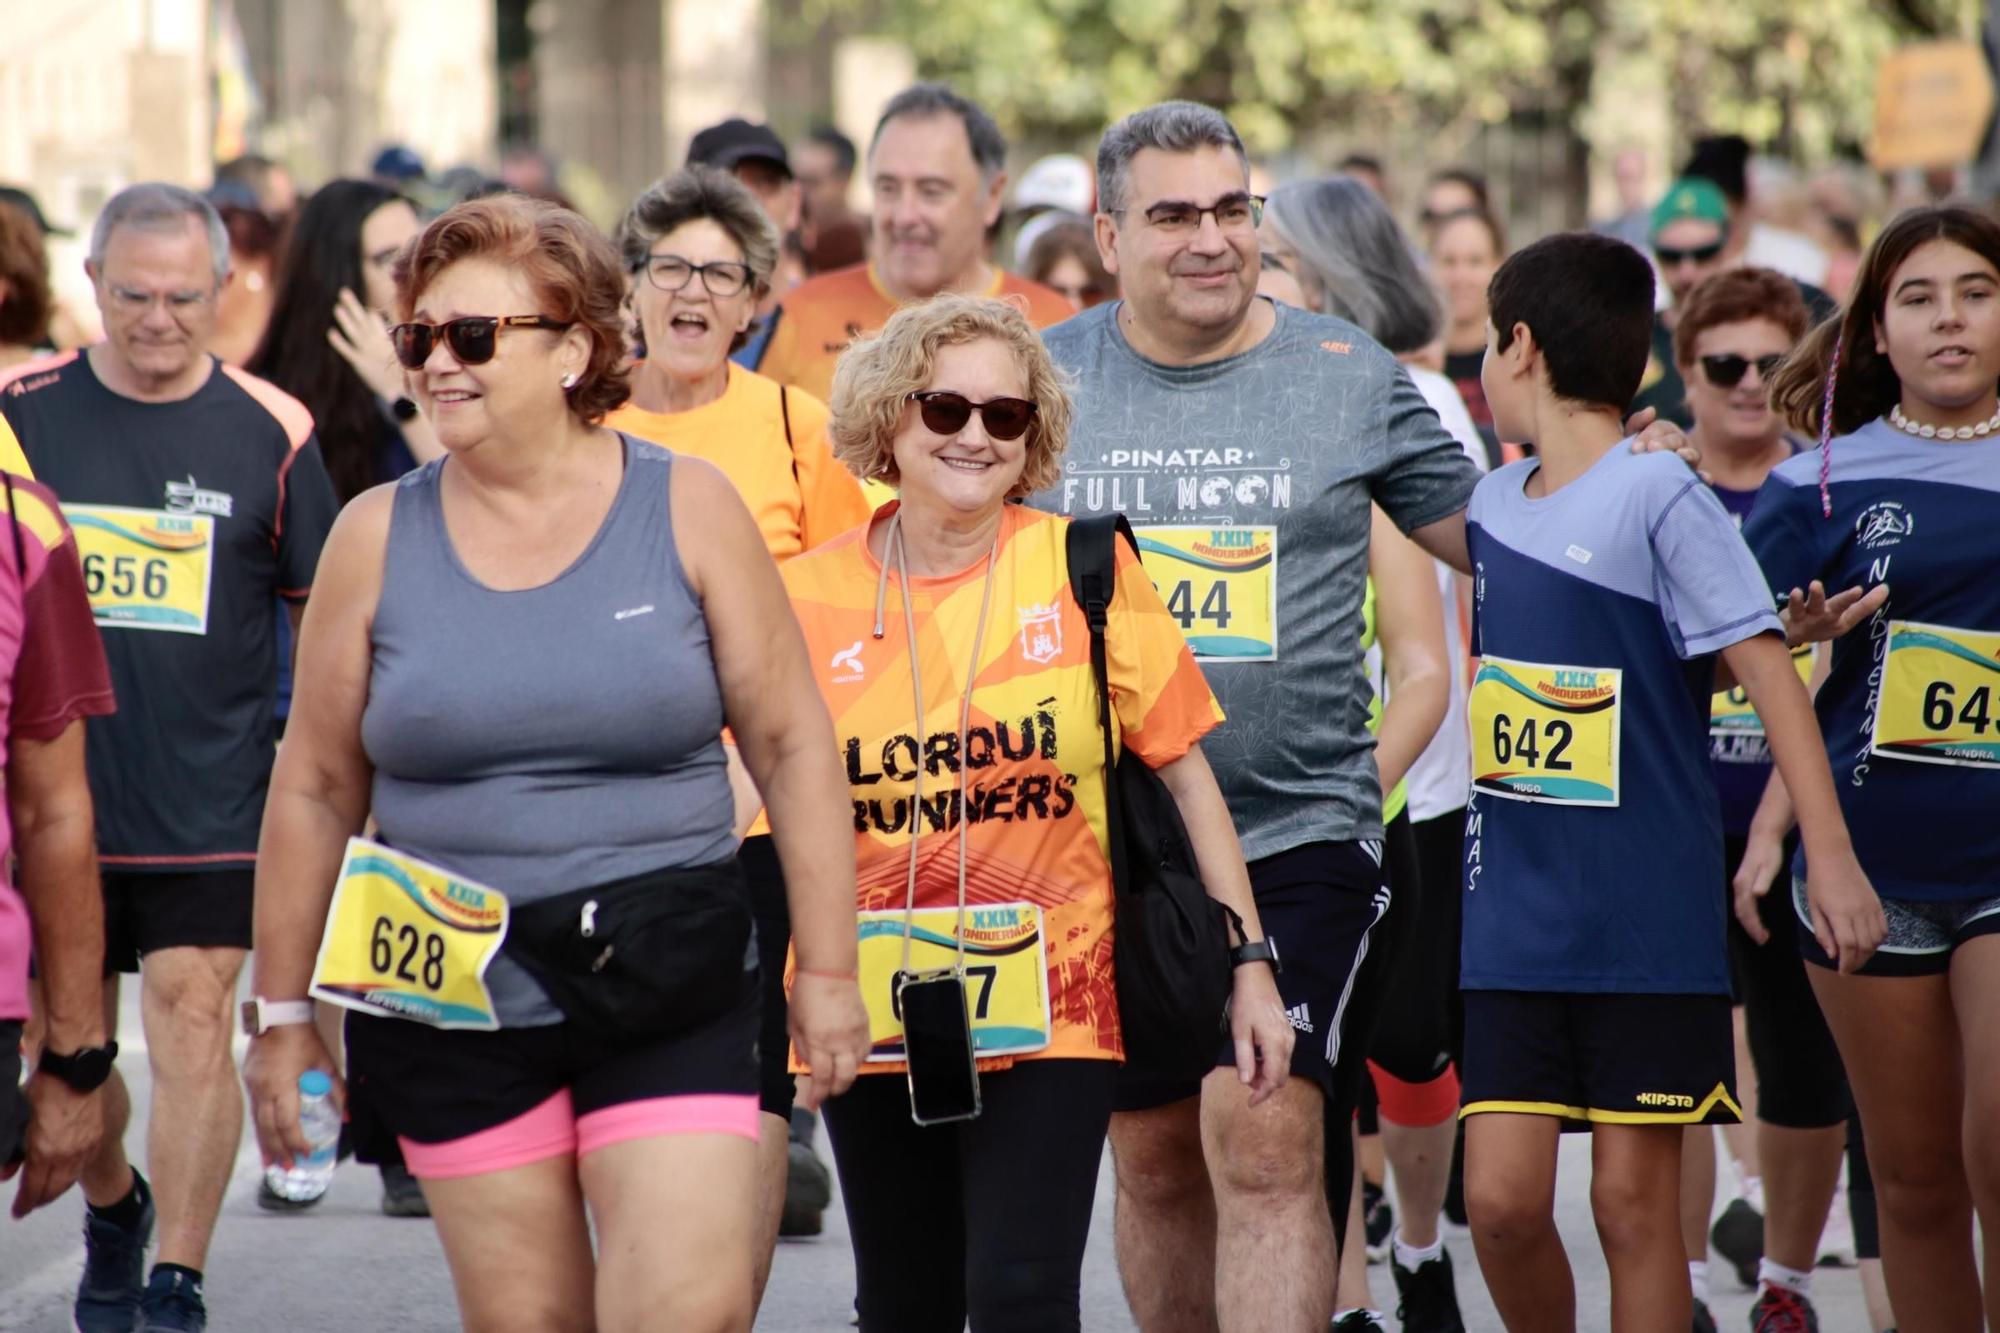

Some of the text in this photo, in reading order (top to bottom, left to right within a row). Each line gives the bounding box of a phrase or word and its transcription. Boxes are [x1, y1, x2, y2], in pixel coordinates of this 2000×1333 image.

[1111, 447, 1243, 468] PINATAR
[1063, 474, 1291, 513] FULL MOON
[1211, 530, 1253, 547] XXIX
[83, 554, 169, 599] 656
[1152, 580, 1231, 629] 44
[1537, 681, 1614, 700] NONDUERMAS
[1554, 670, 1598, 688] XXIX
[1923, 681, 2000, 734] 64
[843, 696, 1058, 785] LORQUÍ
[1493, 713, 1573, 771] 642
[1944, 747, 1995, 760] SANDRA
[1513, 782, 1542, 793] HUGO
[972, 910, 1019, 928] XXIX
[371, 915, 445, 991] 628
